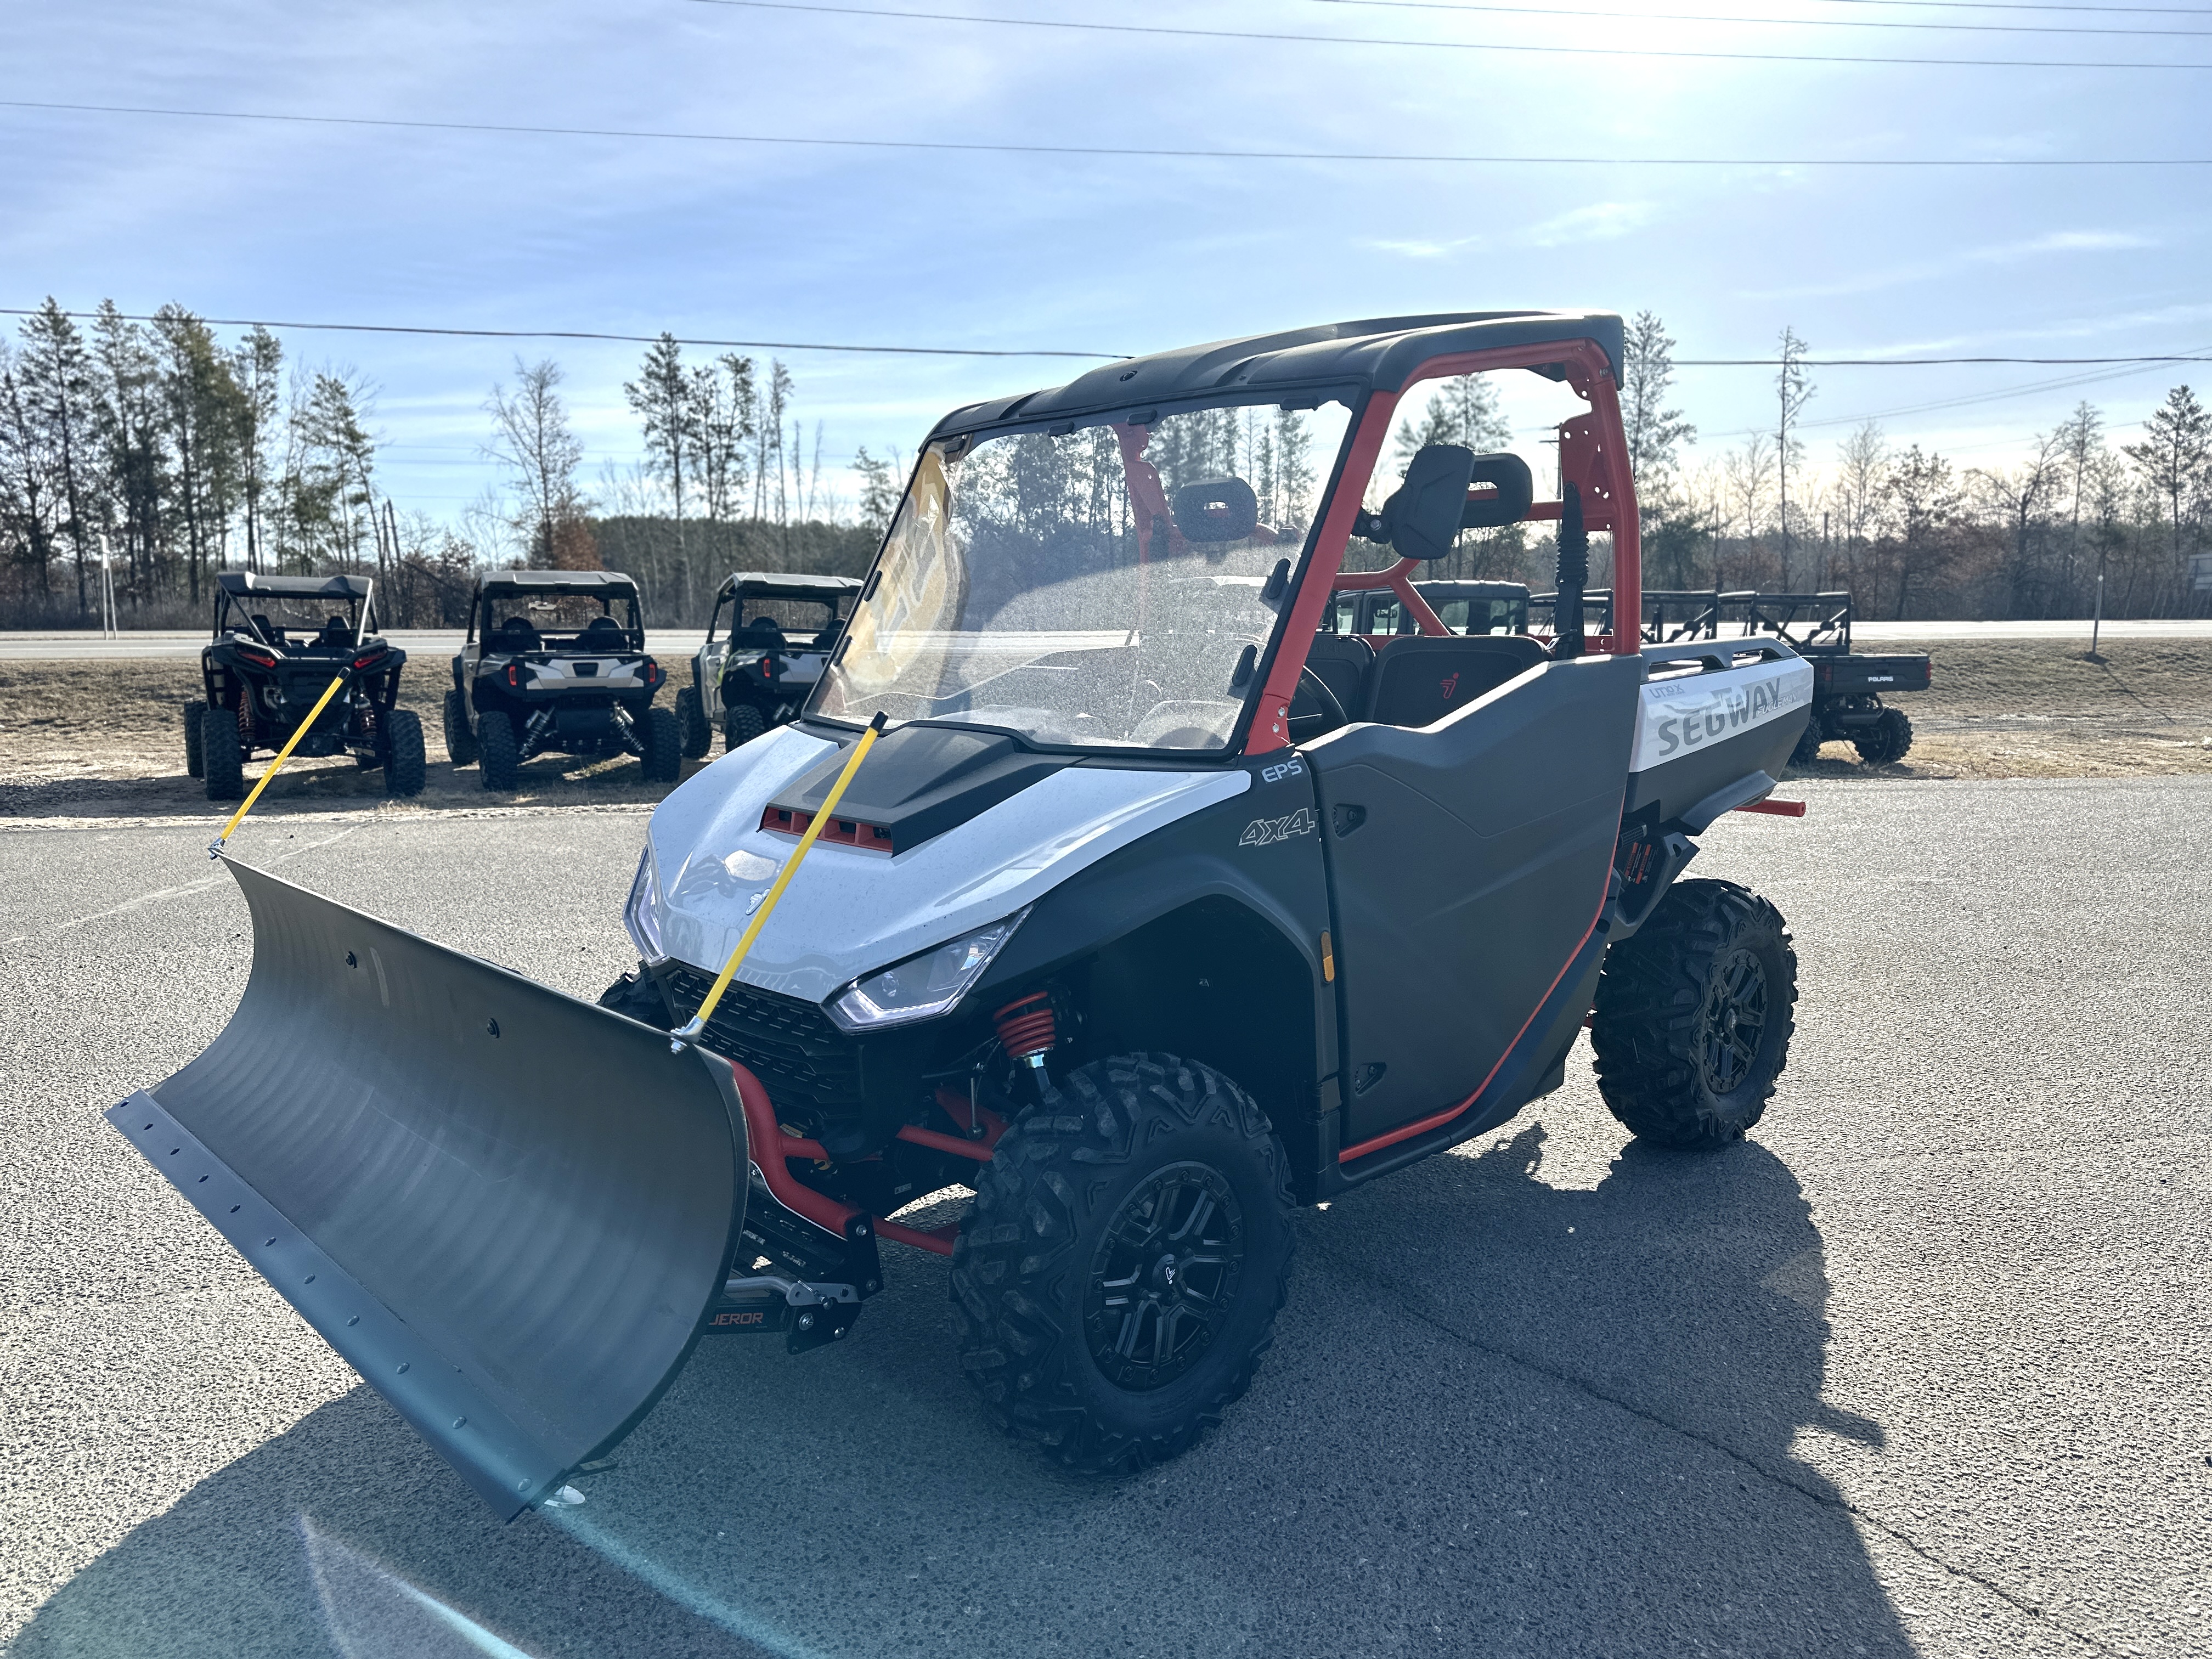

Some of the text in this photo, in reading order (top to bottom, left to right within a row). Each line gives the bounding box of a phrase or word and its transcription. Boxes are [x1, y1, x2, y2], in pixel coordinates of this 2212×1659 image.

[1658, 678, 1781, 757] SEGWAY
[1756, 691, 1798, 718] FUGLEMAN
[1261, 759, 1302, 783] EPS
